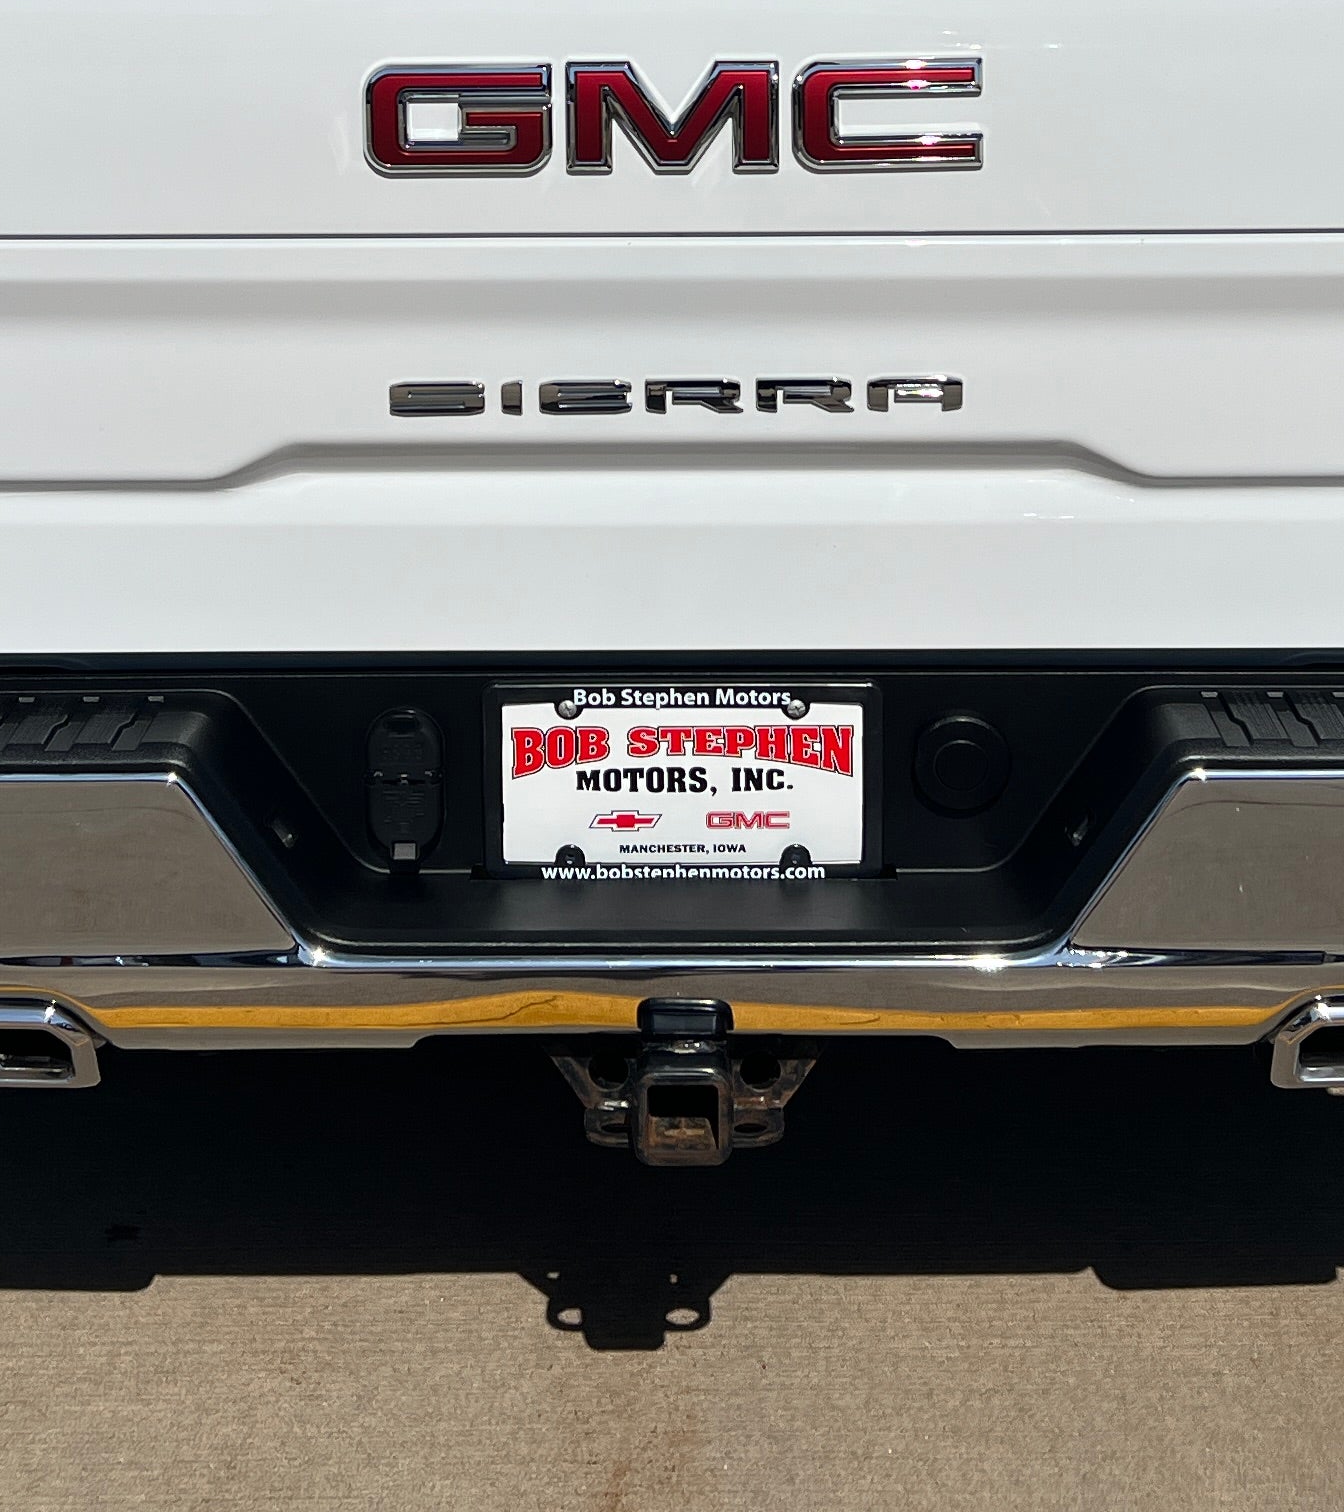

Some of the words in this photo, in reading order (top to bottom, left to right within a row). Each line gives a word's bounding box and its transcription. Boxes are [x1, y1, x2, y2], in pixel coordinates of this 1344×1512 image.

[363, 59, 983, 179] GMC
[389, 377, 964, 417] SIERRA
[573, 688, 616, 706] Bob
[620, 688, 710, 711] Stephen
[715, 688, 792, 706] Motors
[511, 725, 611, 780] BOB
[626, 724, 855, 778] STEPHEN
[576, 766, 718, 797] MOTORS,
[731, 766, 794, 792] INC.
[706, 810, 791, 830] GMC
[619, 843, 710, 855] MANCHESTER,
[713, 843, 747, 854] IOWA
[541, 863, 826, 880] www.bobstephenmotors.com
